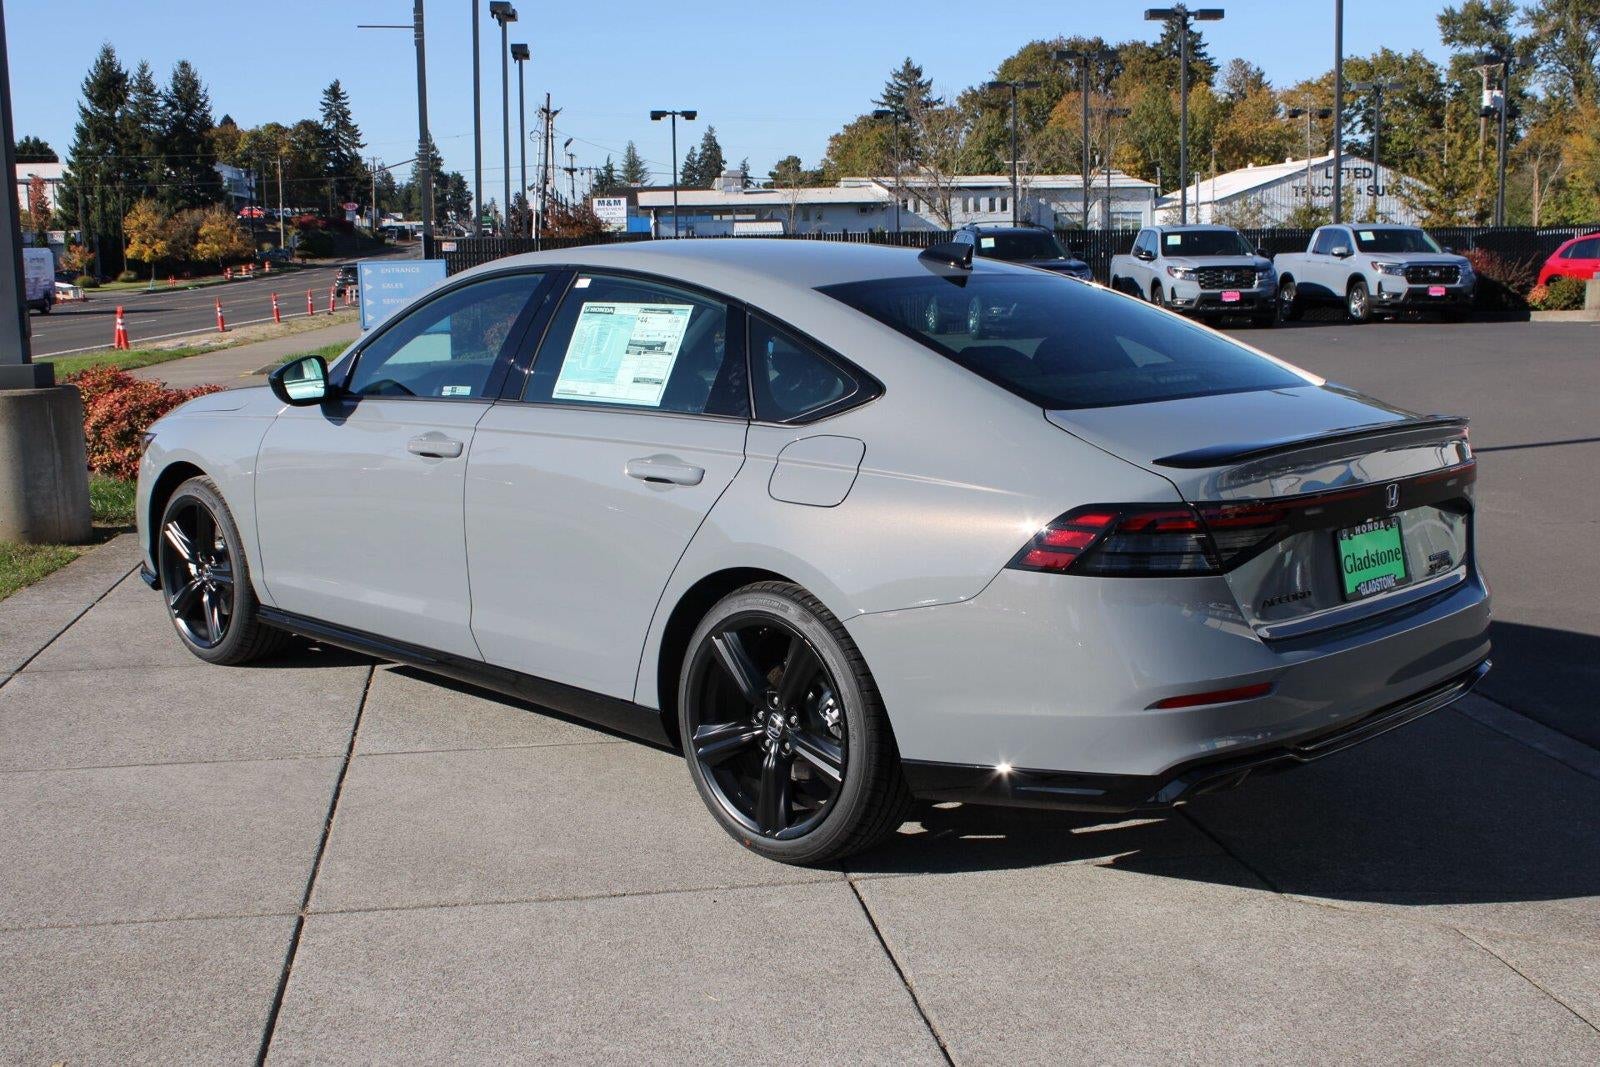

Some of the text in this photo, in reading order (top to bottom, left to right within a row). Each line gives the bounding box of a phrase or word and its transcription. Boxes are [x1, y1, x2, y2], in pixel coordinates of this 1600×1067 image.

[1325, 167, 1372, 179] LFTED
[1354, 520, 1385, 535] HONDA
[1343, 547, 1402, 574] Gladstone
[1360, 575, 1396, 595] GLADSTONE
